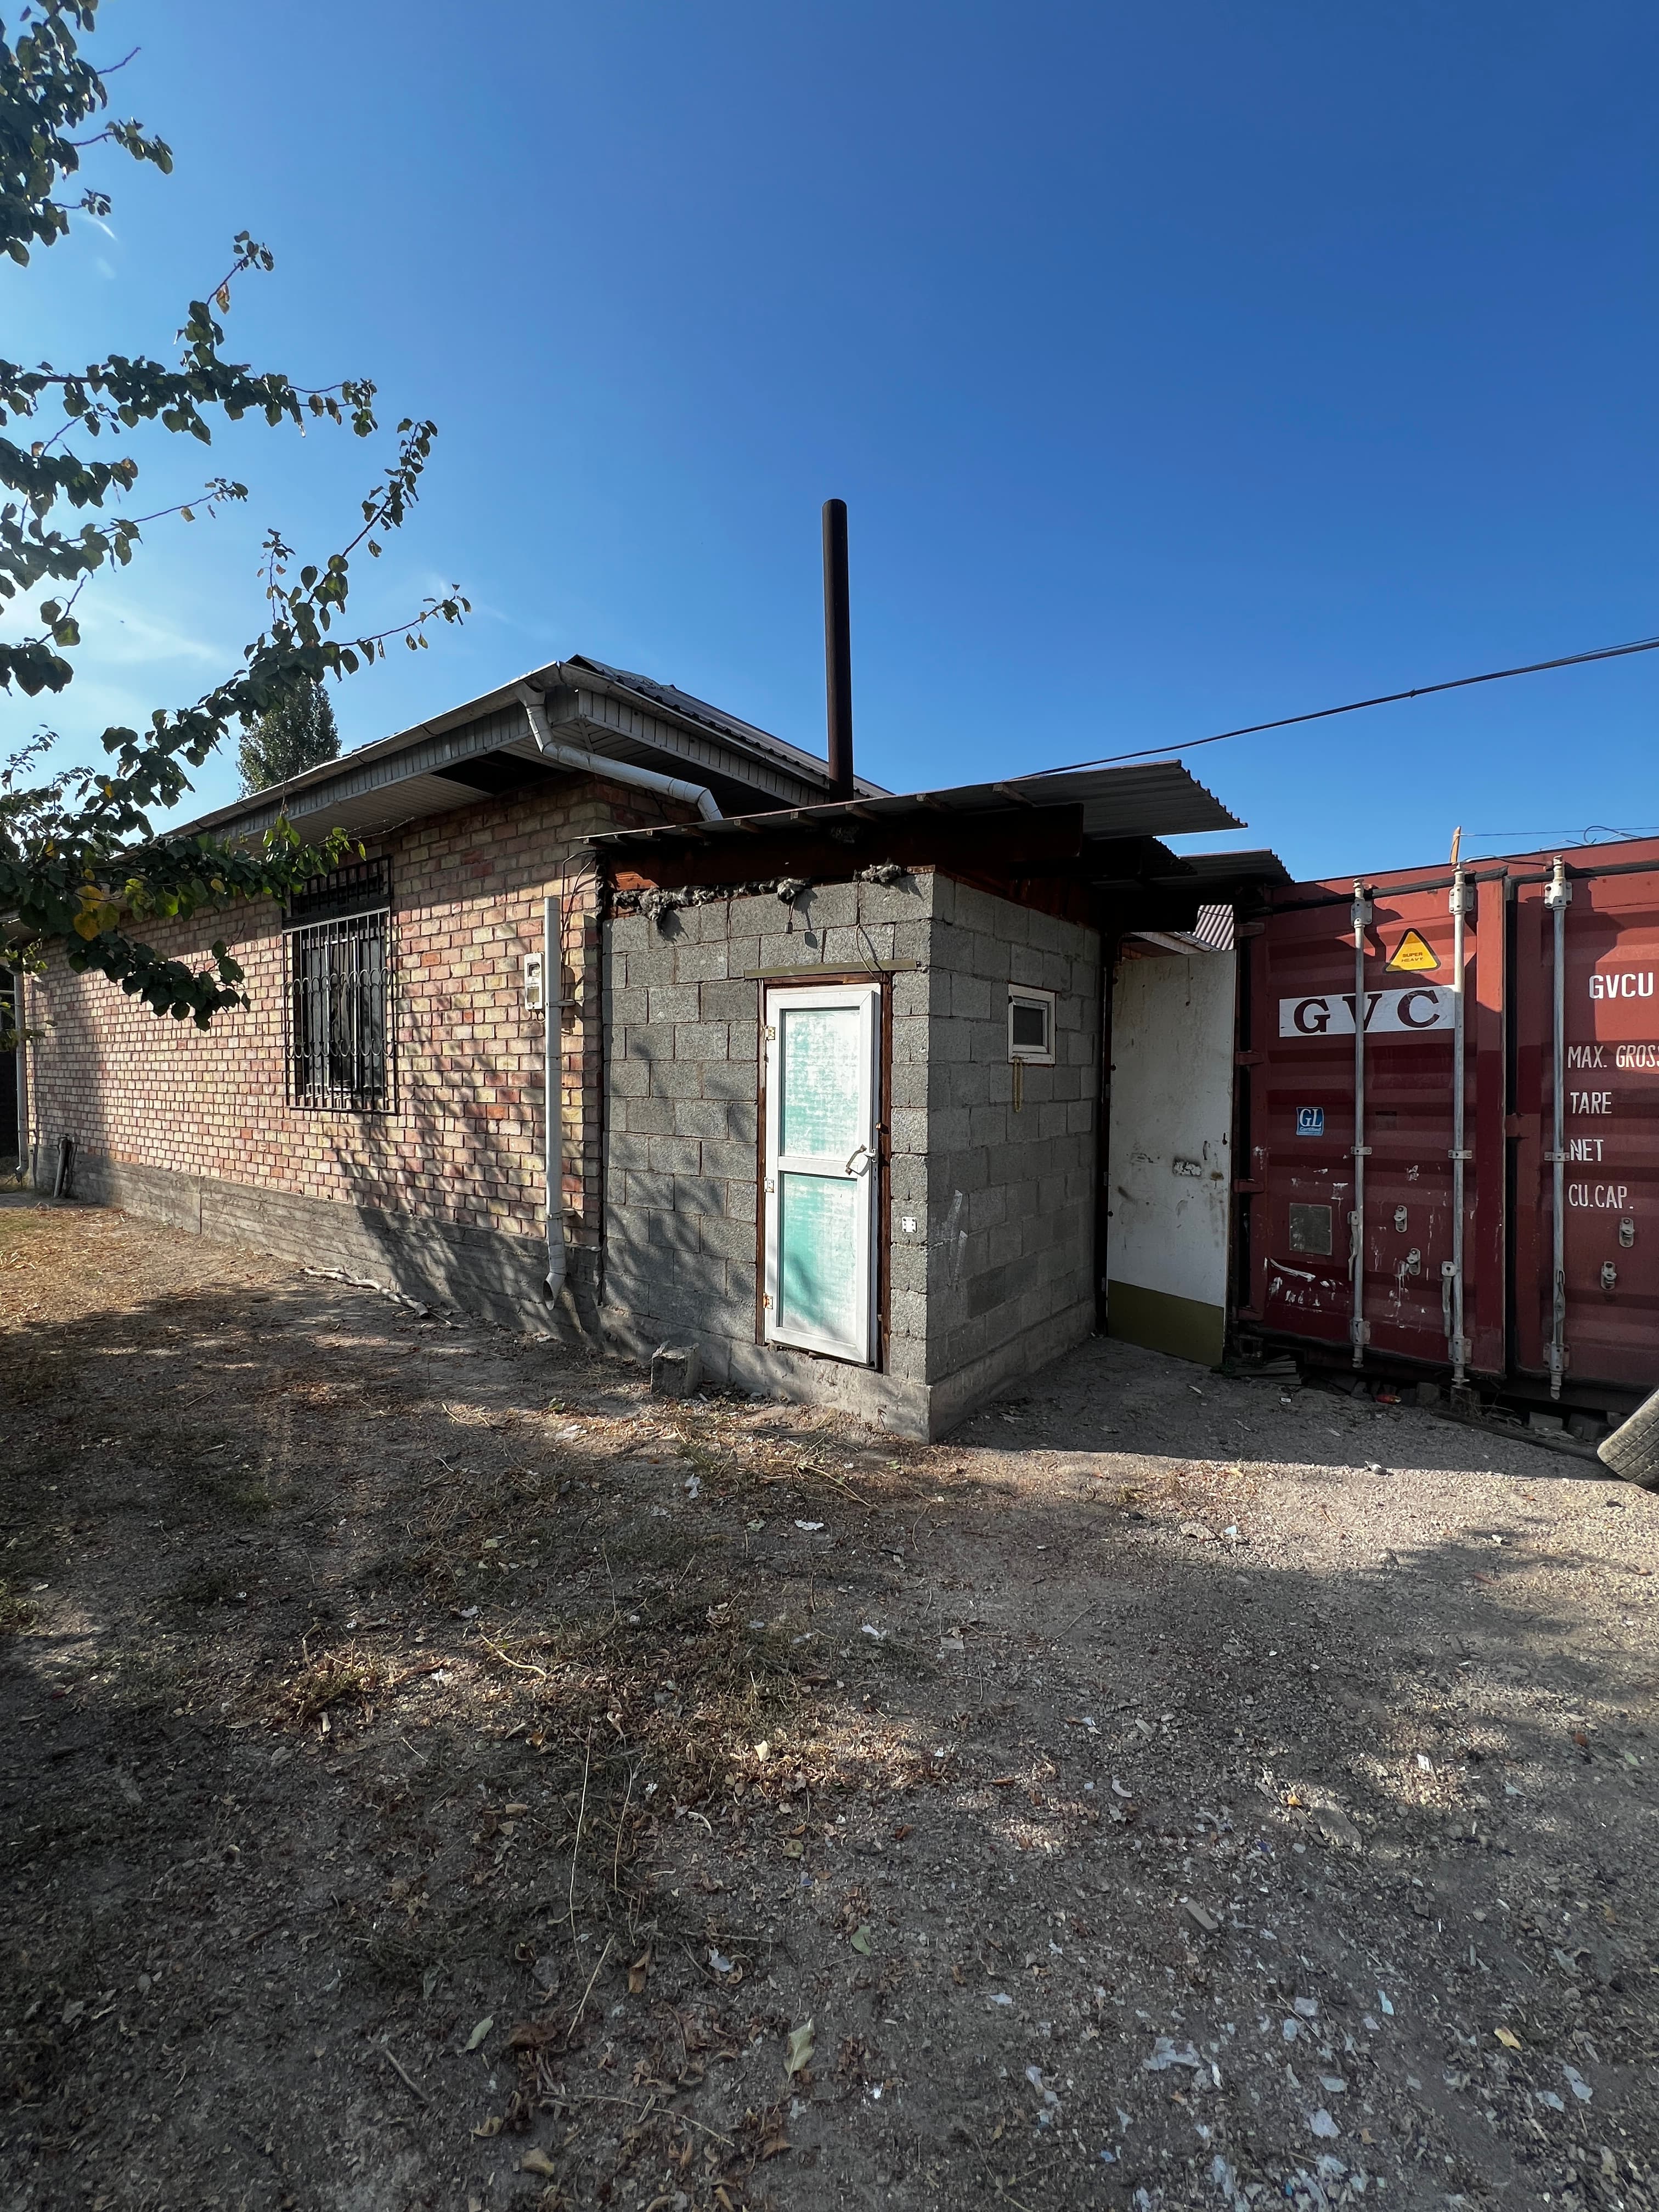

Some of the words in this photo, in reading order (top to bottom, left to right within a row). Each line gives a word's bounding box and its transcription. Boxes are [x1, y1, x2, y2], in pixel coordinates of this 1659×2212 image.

[1589, 972, 1654, 999] GVCU
[1294, 990, 1440, 1034] GVC
[1567, 1046, 1607, 1068] MAX.
[1616, 1045, 1659, 1068] GROS
[1570, 1092, 1612, 1114] TARE
[1299, 1108, 1322, 1127] GL
[1570, 1139, 1604, 1161] NET
